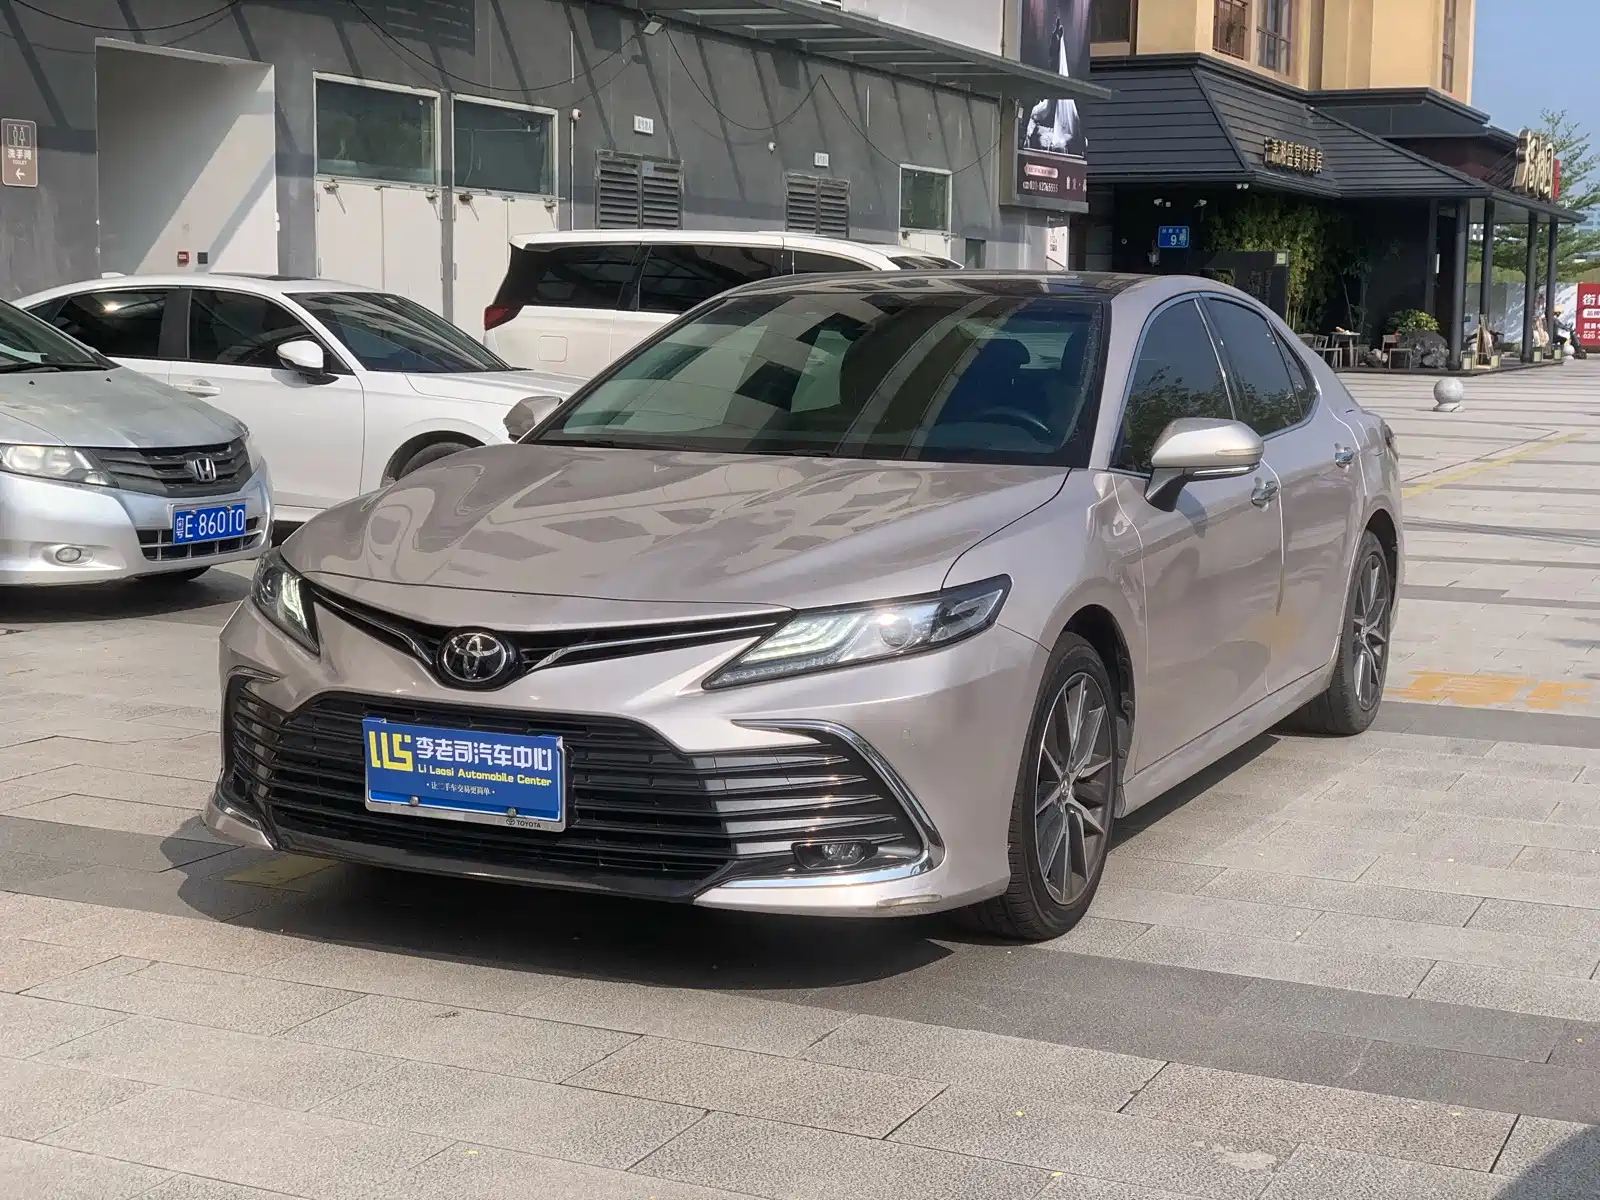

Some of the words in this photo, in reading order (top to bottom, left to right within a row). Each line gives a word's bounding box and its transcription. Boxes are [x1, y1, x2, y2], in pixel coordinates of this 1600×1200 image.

[415, 736, 552, 771] 李老司汽车中心
[418, 763, 427, 773] Li
[429, 766, 455, 777] Laosi
[457, 768, 514, 783] Automobile
[516, 774, 552, 787] Center
[516, 820, 542, 829] TOYOTA
